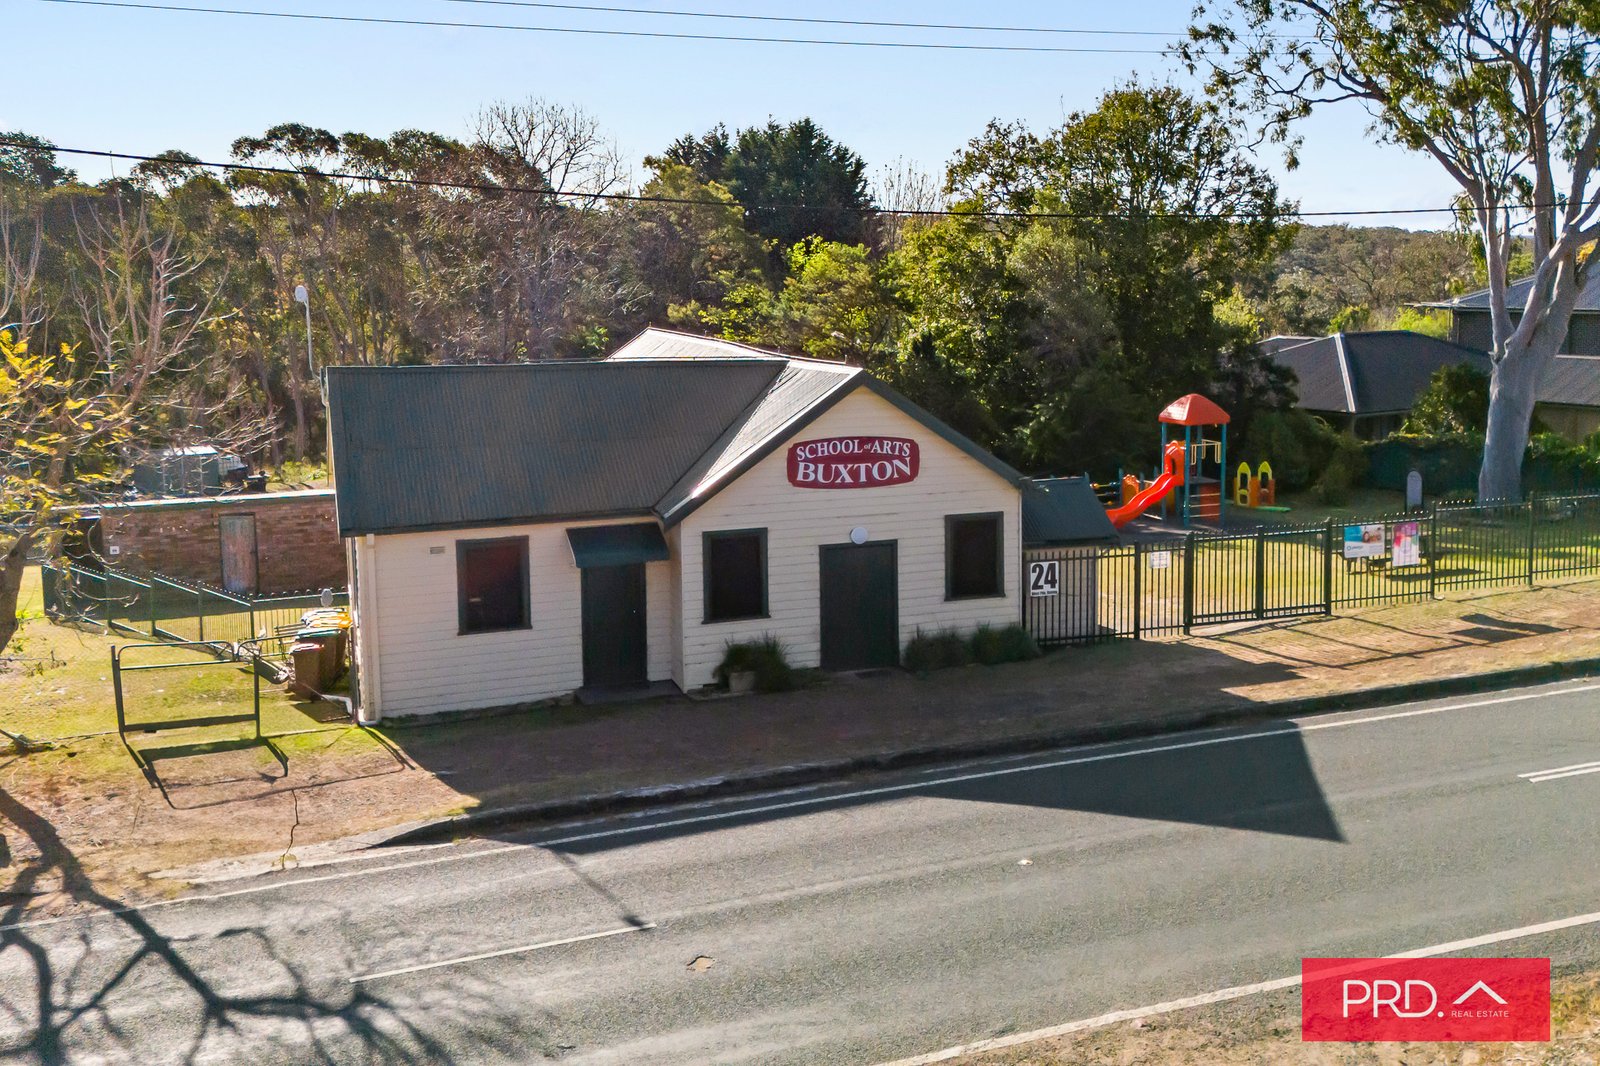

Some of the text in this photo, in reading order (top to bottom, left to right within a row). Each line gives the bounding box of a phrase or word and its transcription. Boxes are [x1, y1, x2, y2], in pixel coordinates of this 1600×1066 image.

[796, 439, 863, 461] SCHOOL
[871, 440, 911, 457] ARTS
[796, 457, 911, 483] BUXTON
[1031, 562, 1058, 590] 24
